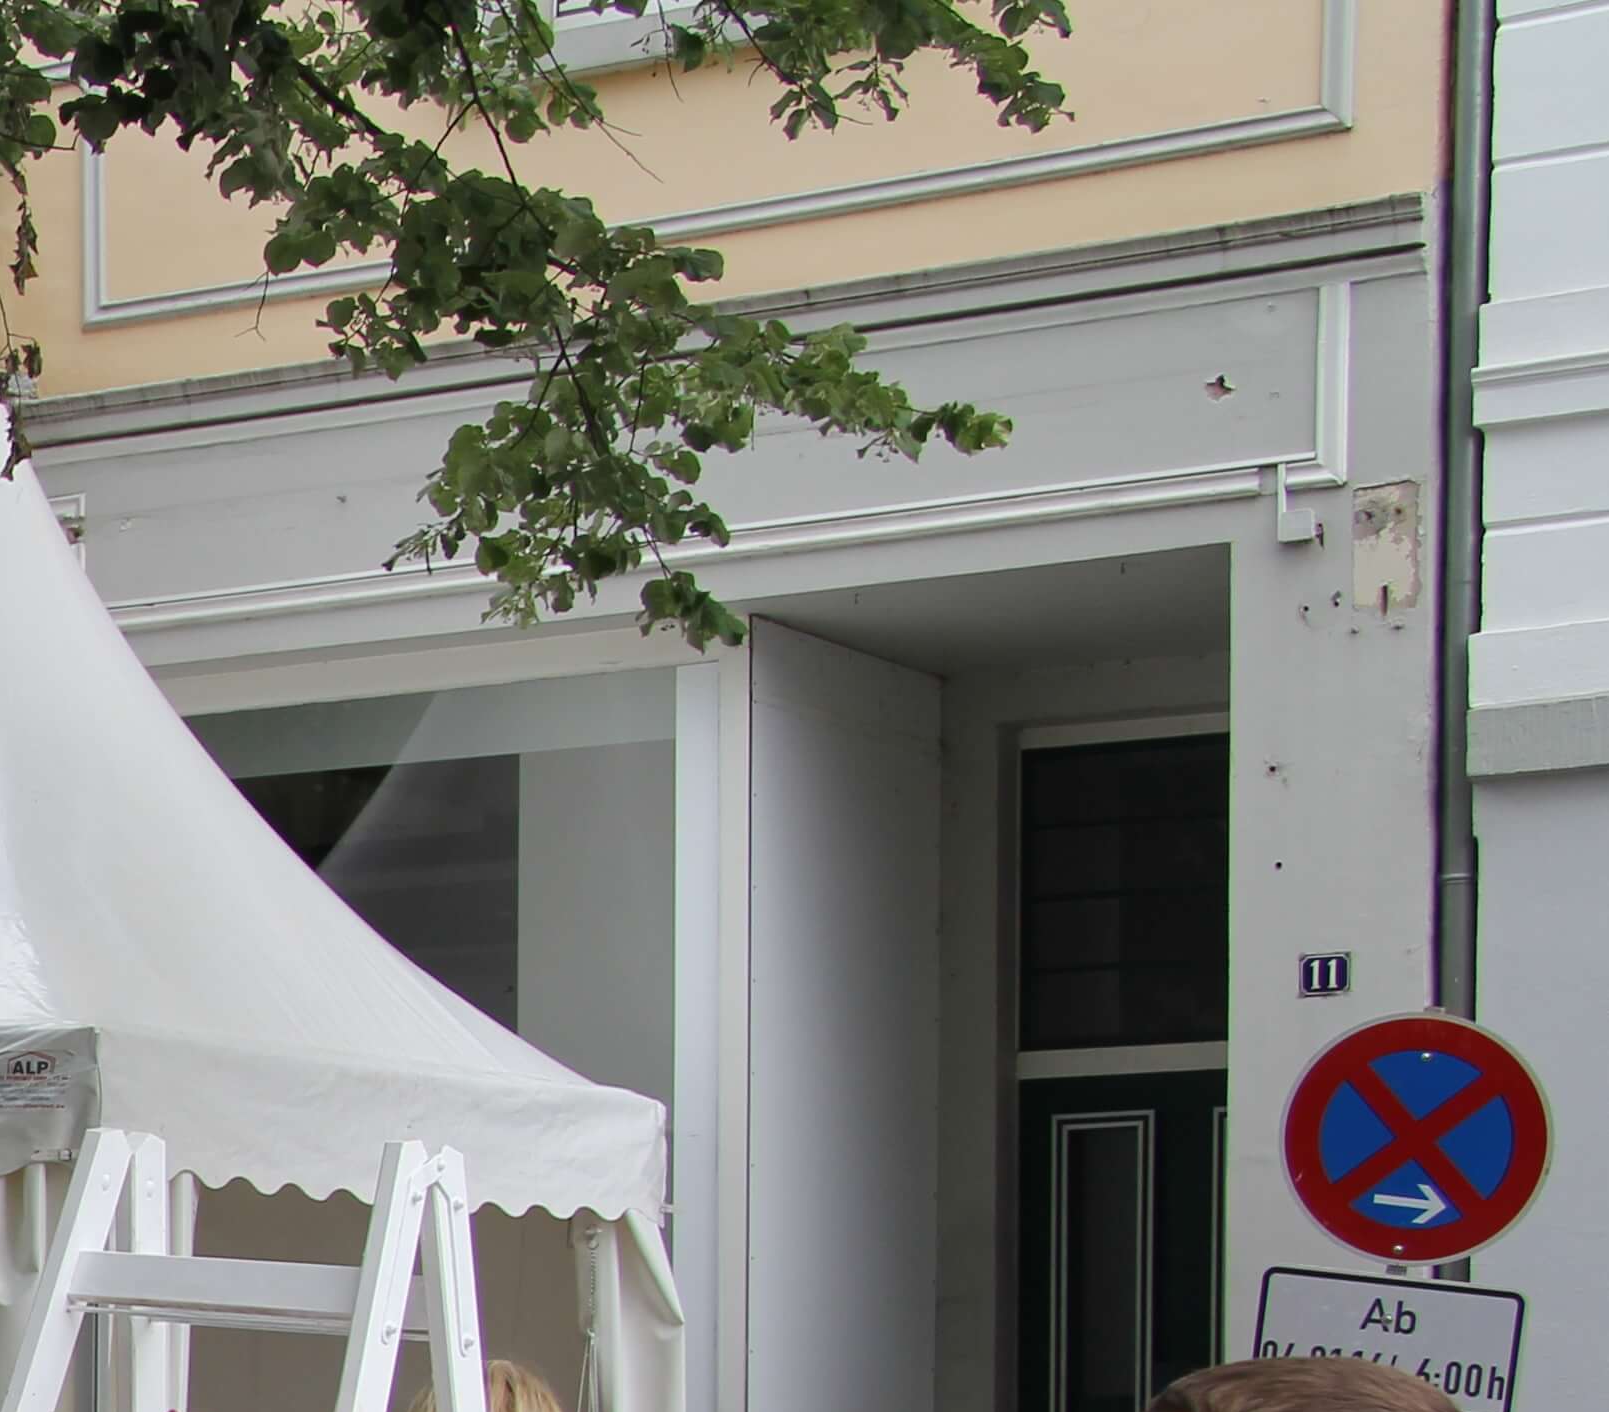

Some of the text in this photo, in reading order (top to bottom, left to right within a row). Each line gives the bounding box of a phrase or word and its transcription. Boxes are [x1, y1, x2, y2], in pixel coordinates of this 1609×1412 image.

[1309, 958, 1339, 990] 11
[13, 1060, 49, 1075] ALP
[1359, 1297, 1417, 1335] Ab
